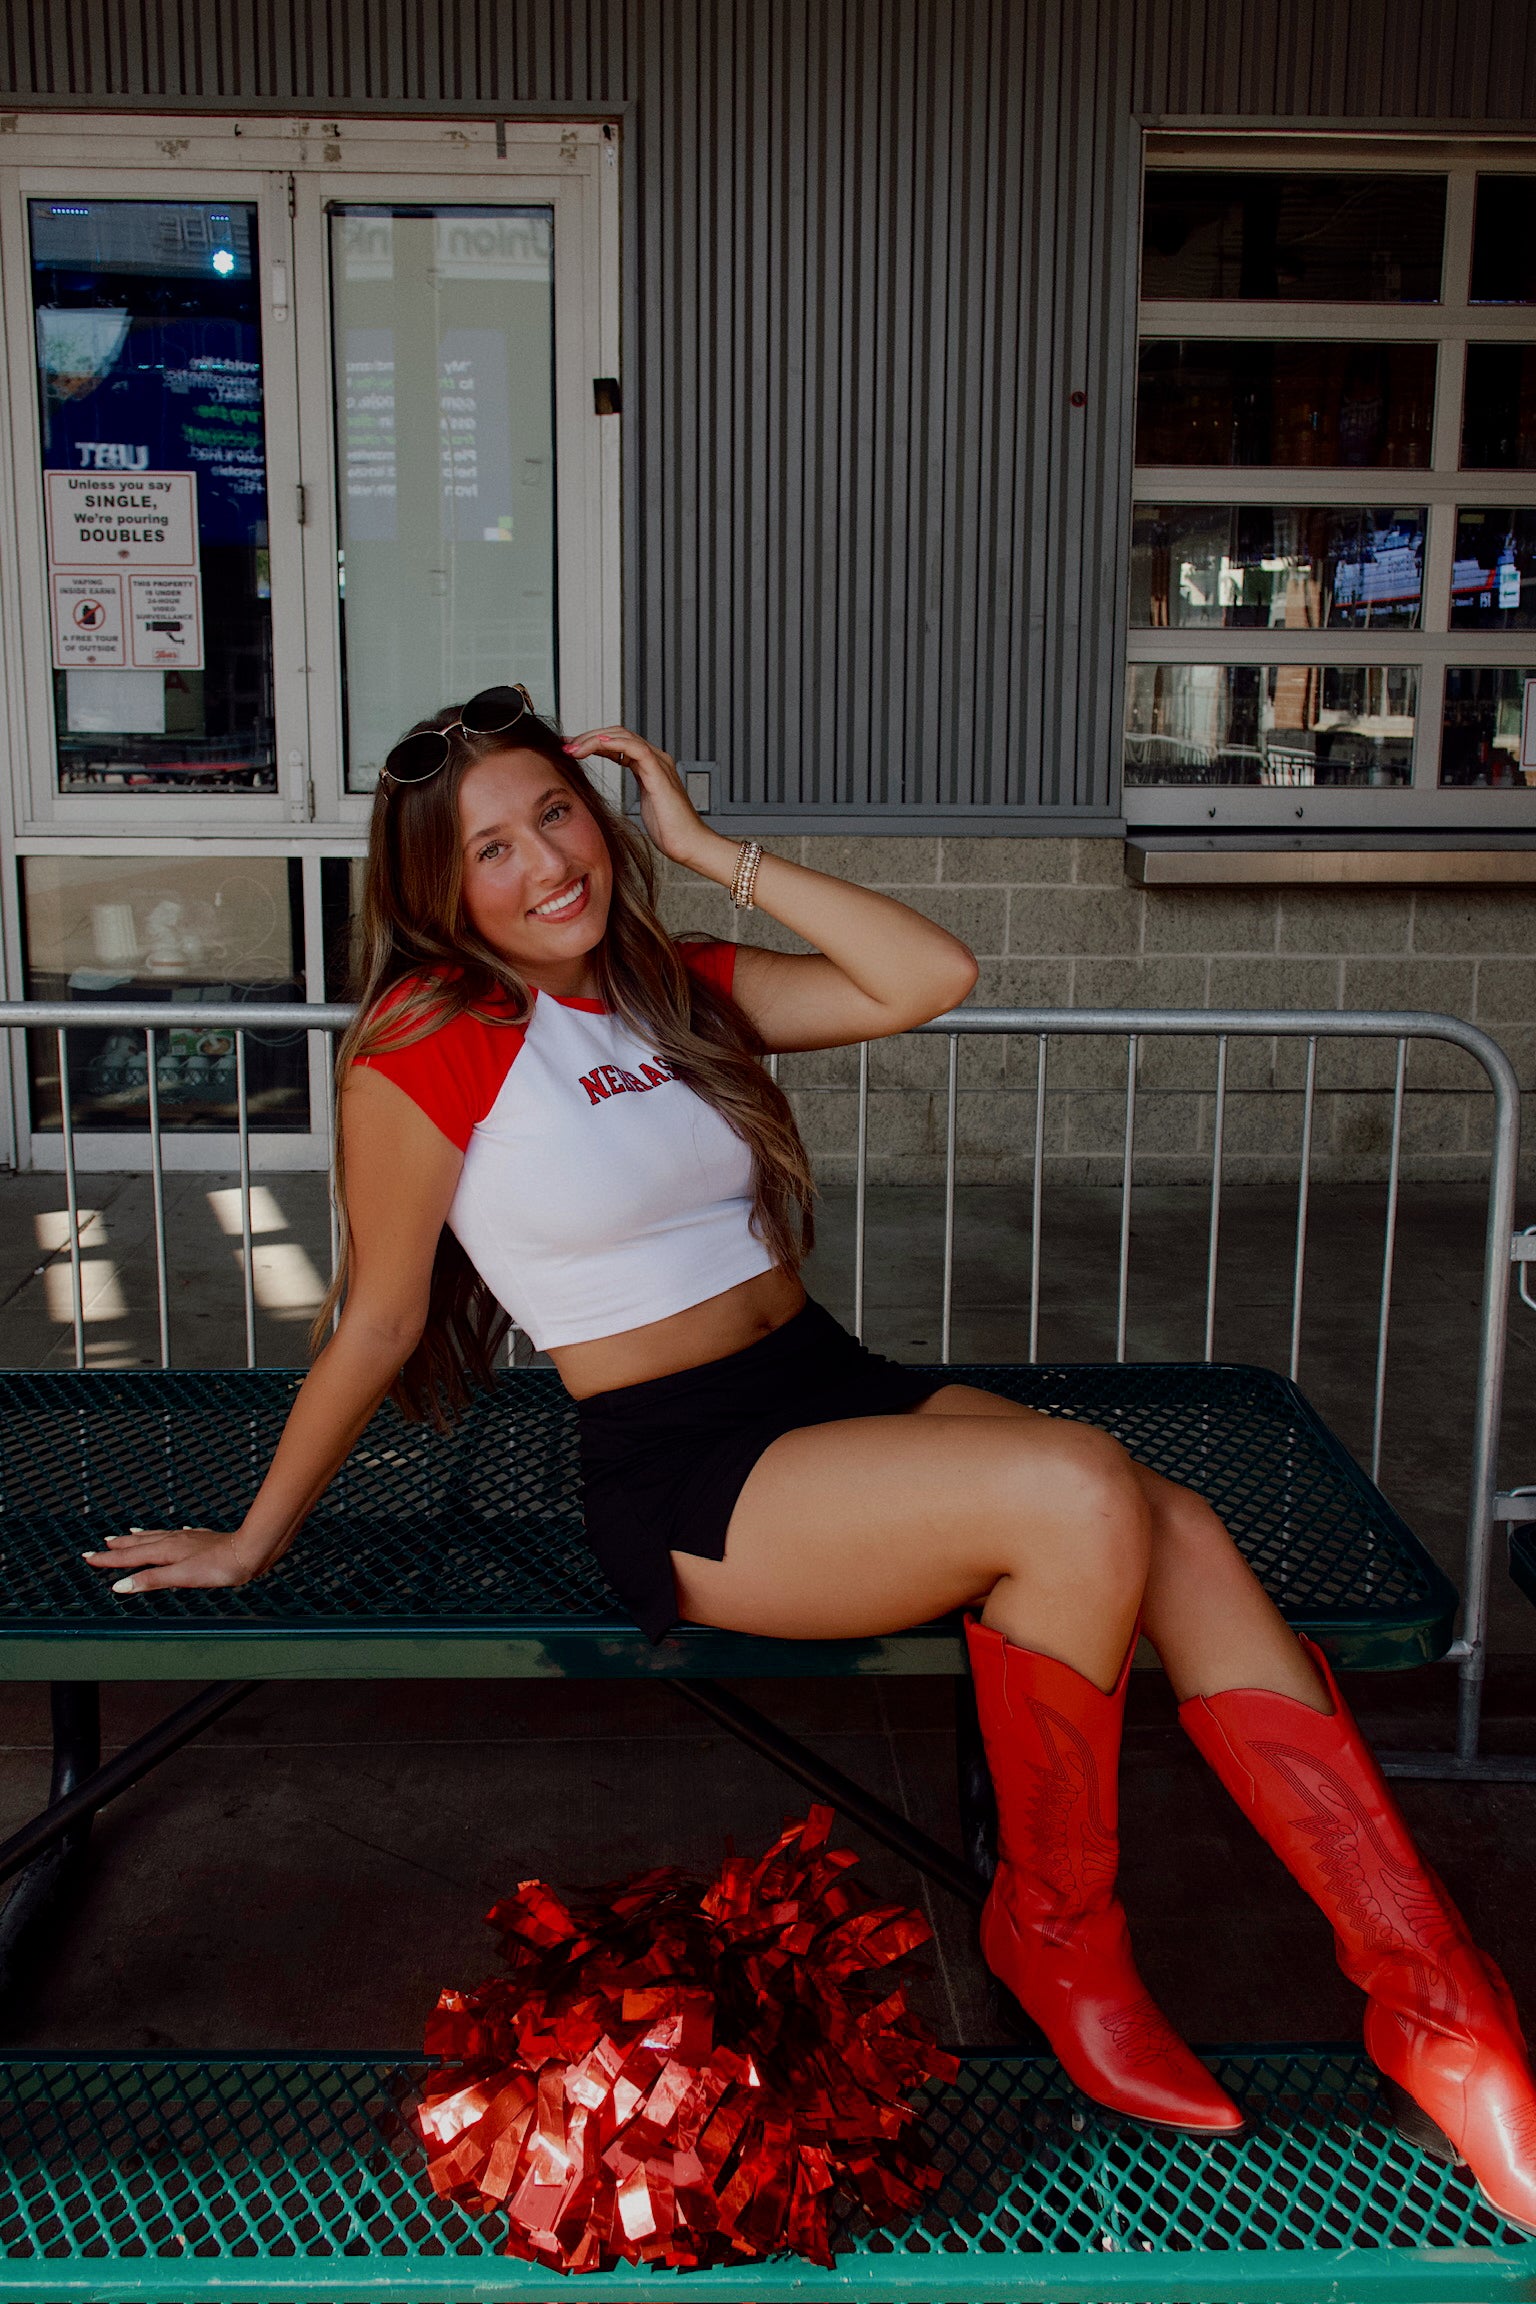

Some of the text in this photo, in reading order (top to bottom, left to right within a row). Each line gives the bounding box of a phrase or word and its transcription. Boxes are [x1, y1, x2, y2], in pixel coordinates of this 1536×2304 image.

[68, 479, 172, 493] Unless you say
[85, 496, 158, 510] SINGLE,
[74, 513, 169, 526] We're pouring
[80, 530, 165, 543] DOUBLES
